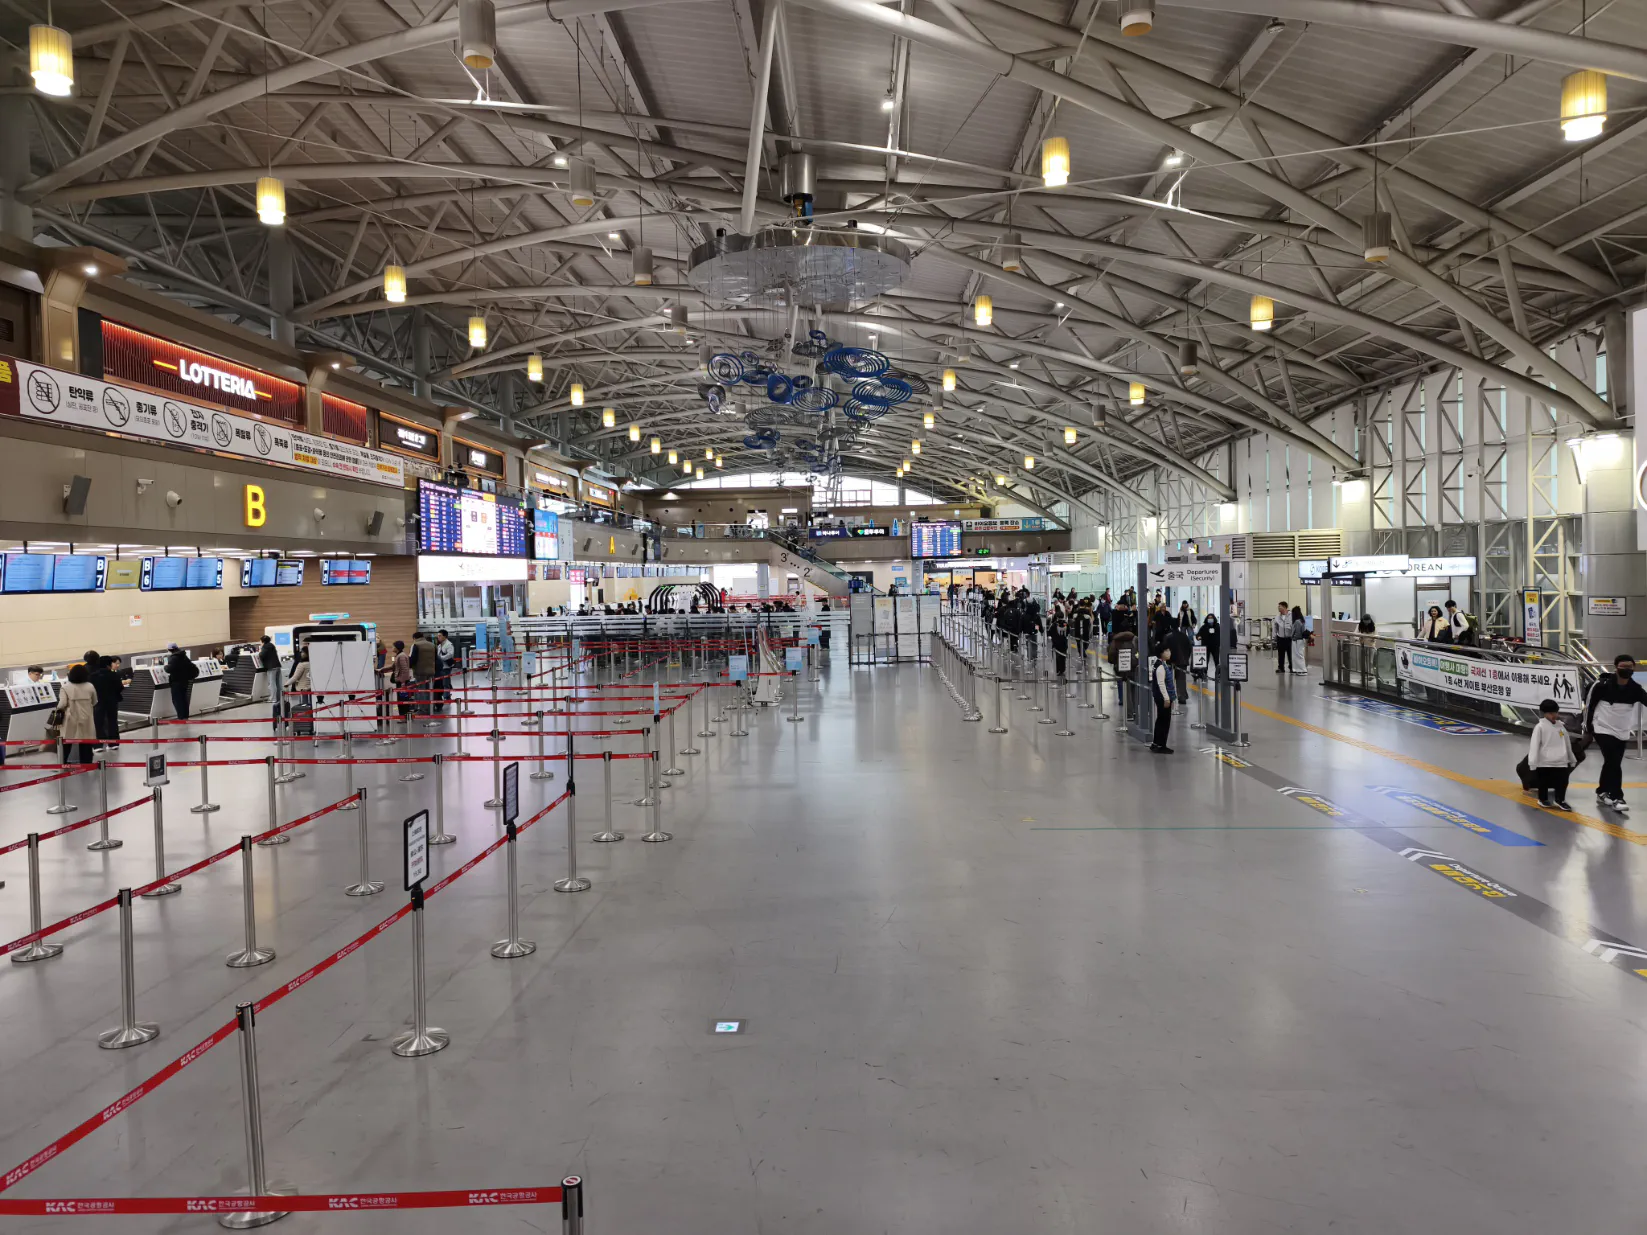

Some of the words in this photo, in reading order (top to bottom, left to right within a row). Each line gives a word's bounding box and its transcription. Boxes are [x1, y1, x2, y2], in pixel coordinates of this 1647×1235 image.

[180, 359, 256, 400] LOTTERIA
[69, 386, 94, 402] 탄약류
[136, 402, 157, 416] 총기류
[190, 420, 208, 433] 충격기
[245, 484, 266, 527] B
[97, 560, 104, 570] B
[145, 560, 150, 571] B
[97, 575, 103, 586] 7
[144, 575, 149, 585] 6
[1168, 571, 1184, 580] 출국
[1470, 665, 1487, 678] 국제선
[1488, 669, 1510, 681] 1층에서
[1511, 672, 1530, 684] 이용해
[1530, 674, 1552, 686] 주세요.
[1445, 675, 1453, 685] 1층
[1454, 678, 1463, 688] 4번
[1464, 680, 1480, 691] 게이트
[1481, 684, 1504, 696] 부산은행
[1505, 687, 1511, 697] 옆
[181, 1050, 195, 1066] KAC
[103, 1101, 121, 1120] KAC
[5, 1163, 29, 1185] KAC
[329, 1198, 358, 1208] KAC
[469, 1193, 498, 1203] KAC
[46, 1202, 75, 1212] KAC
[187, 1200, 216, 1210] KAC
[218, 1200, 255, 1208] 한국공항공사
